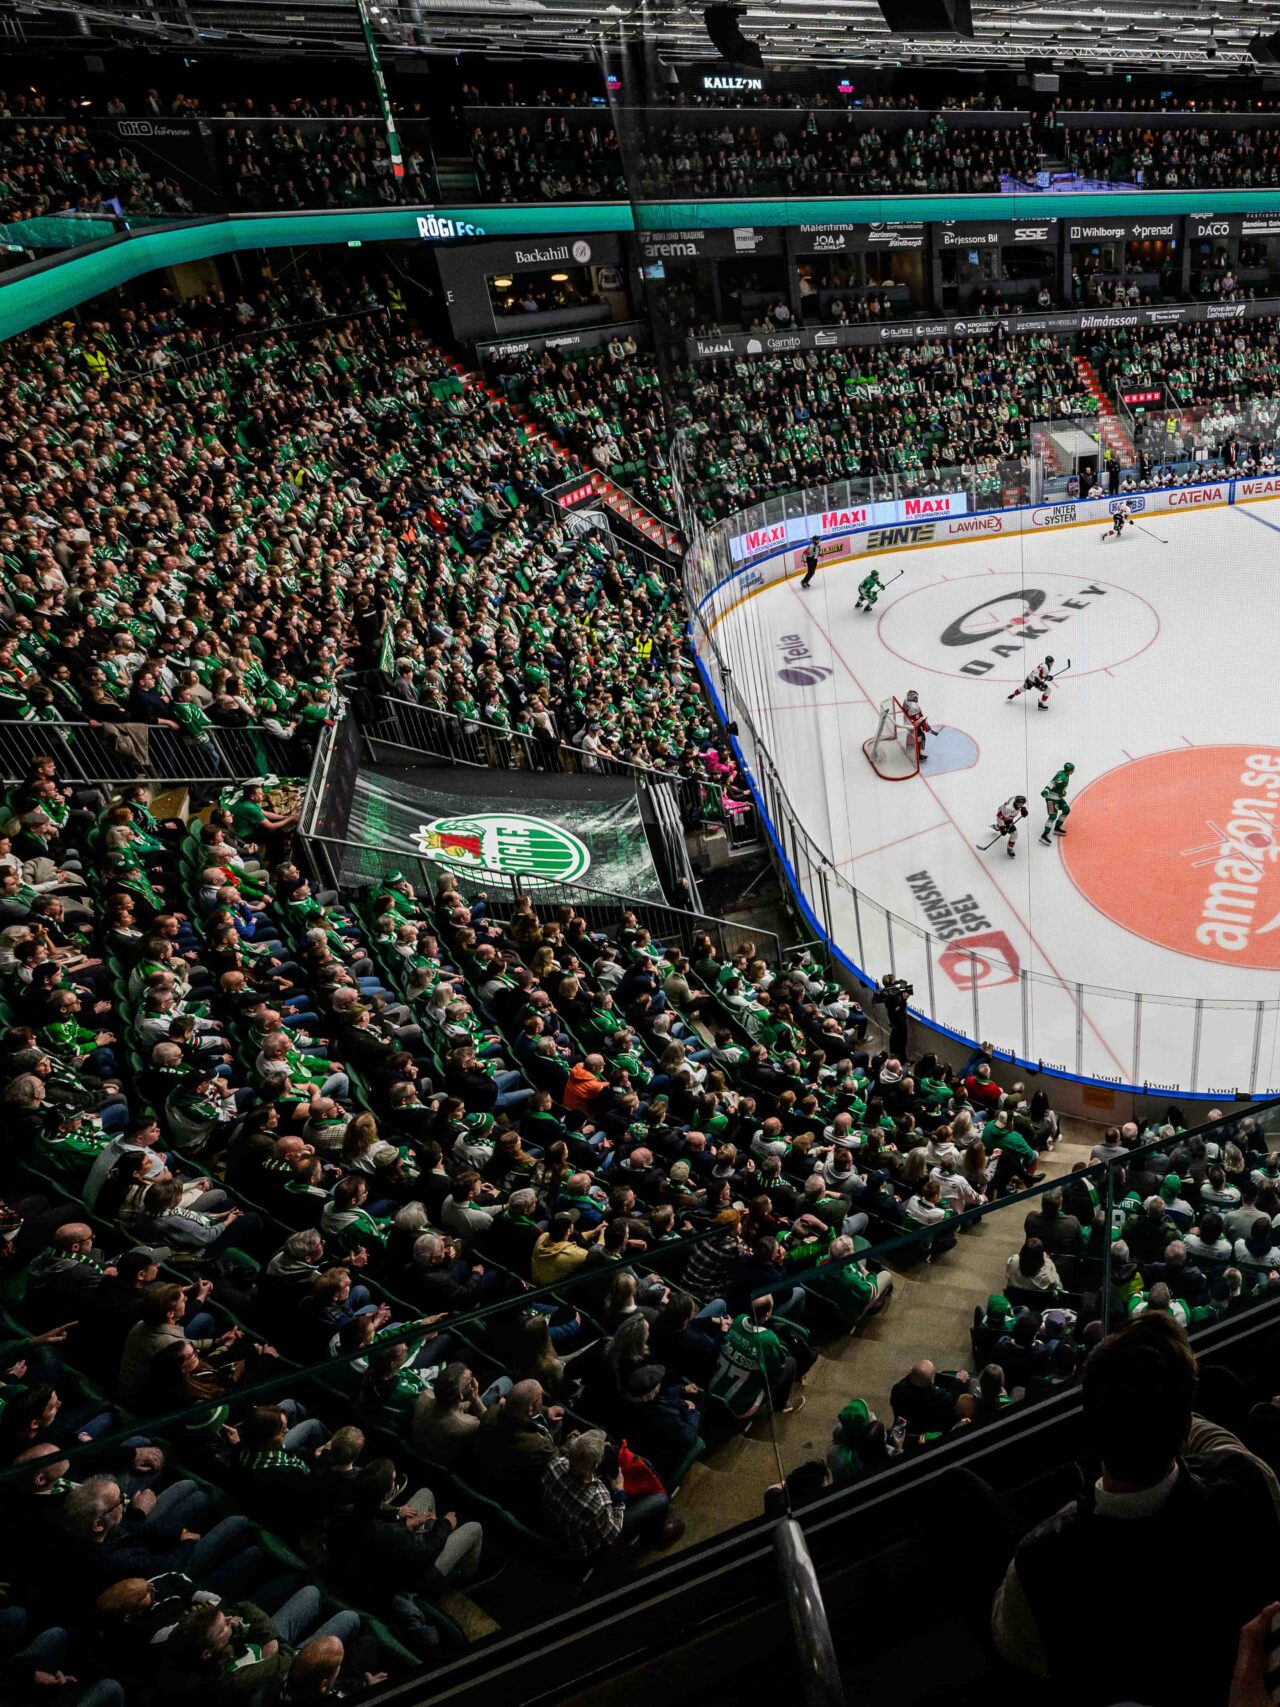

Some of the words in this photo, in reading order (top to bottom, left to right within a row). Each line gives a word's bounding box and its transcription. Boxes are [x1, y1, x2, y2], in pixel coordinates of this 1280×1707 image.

[988, 233, 998, 243] Bil
[1013, 227, 1049, 241] SSE
[1082, 226, 1125, 238] Wihlborgs
[1198, 225, 1229, 236] DACO
[515, 246, 569, 264] Backahill
[1081, 315, 1137, 328] bilmånsson
[1125, 392, 1159, 402] CRAMO
[1169, 488, 1222, 505] CATENA
[905, 498, 950, 516] MAXI
[1053, 505, 1076, 515] INTER
[822, 509, 867, 529] MAXI
[1044, 513, 1076, 525] SYSTEM
[746, 526, 785, 551] MAXI
[960, 583, 1108, 676] OAKLEY
[778, 634, 804, 665] Telia
[905, 869, 966, 942] SVENSKA
[949, 894, 991, 934] SPEL
